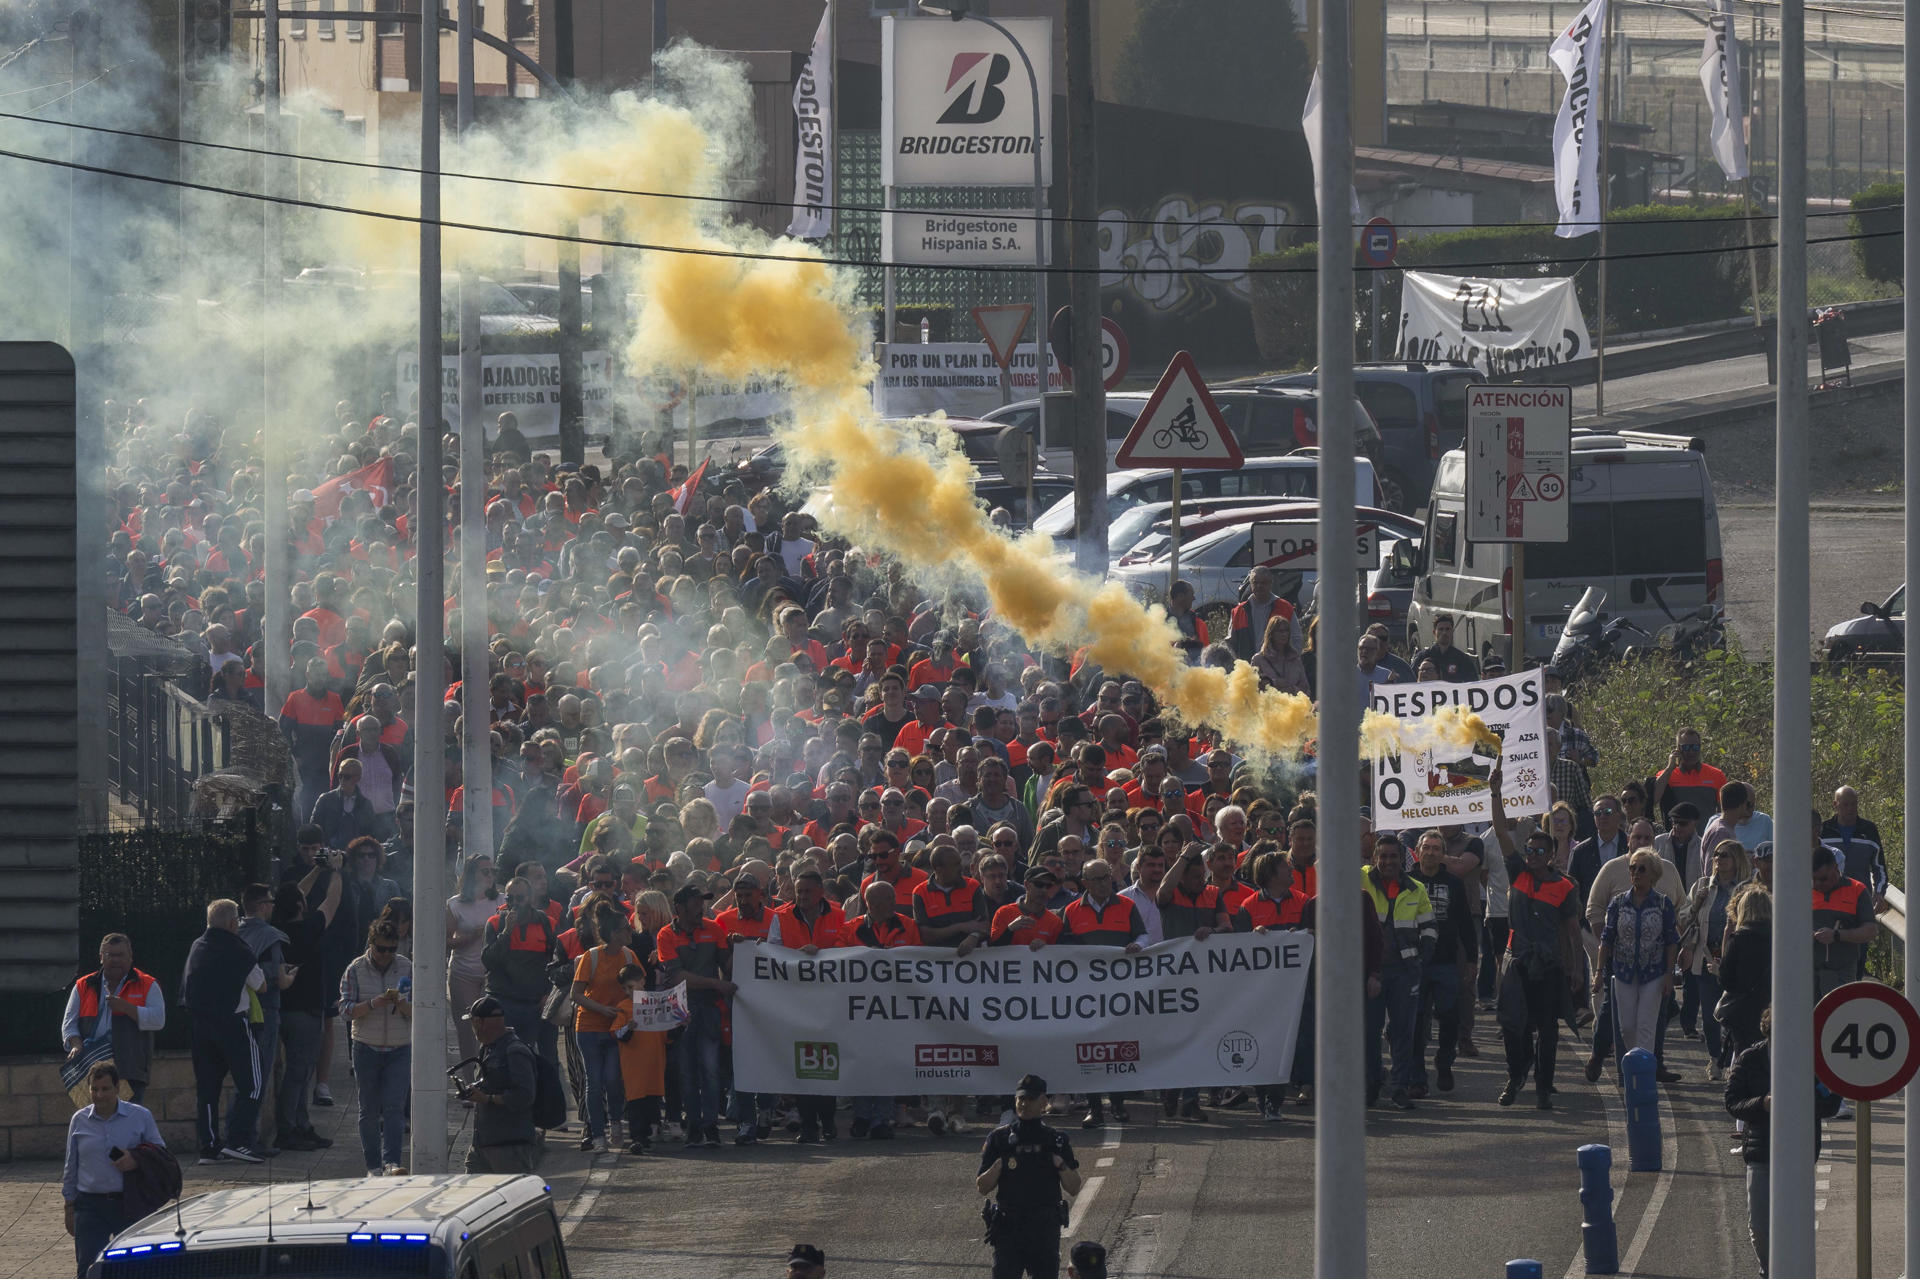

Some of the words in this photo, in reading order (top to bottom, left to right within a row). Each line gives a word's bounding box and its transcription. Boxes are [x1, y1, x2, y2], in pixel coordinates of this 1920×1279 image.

[926, 219, 1017, 240] Bridgestone
[922, 237, 988, 252] Hispania
[992, 237, 1021, 250] S.A.
[891, 353, 918, 369] POR
[922, 353, 941, 369] UN
[944, 353, 978, 369] PLAN
[902, 376, 919, 388] LOS
[921, 375, 985, 388] TRABAJADORES
[987, 375, 998, 387] DE
[484, 391, 545, 405] DEFENSA
[1472, 390, 1564, 408] ATENCIÓN
[1543, 483, 1559, 493] 30
[1264, 537, 1369, 556] TORS
[1374, 680, 1539, 718] DESPIDOS
[1518, 733, 1539, 743] AZSA
[1509, 751, 1539, 762] SNIACE
[1401, 804, 1459, 819] HELGUERA
[1468, 802, 1484, 812] OS
[754, 957, 788, 981] EN
[798, 958, 1022, 984] BRIDGESTONE
[1033, 959, 1079, 984] NO
[1089, 951, 1200, 982] SOBRA
[1208, 944, 1302, 973] NADIE
[848, 995, 970, 1021] FALTAN
[982, 987, 1200, 1022] SOLUCIONES
[1223, 1038, 1253, 1053] SITB
[1831, 1023, 1897, 1060] 40
[1078, 1045, 1118, 1061] UGT
[915, 1067, 971, 1078] industria
[1106, 1063, 1137, 1074] FICA
